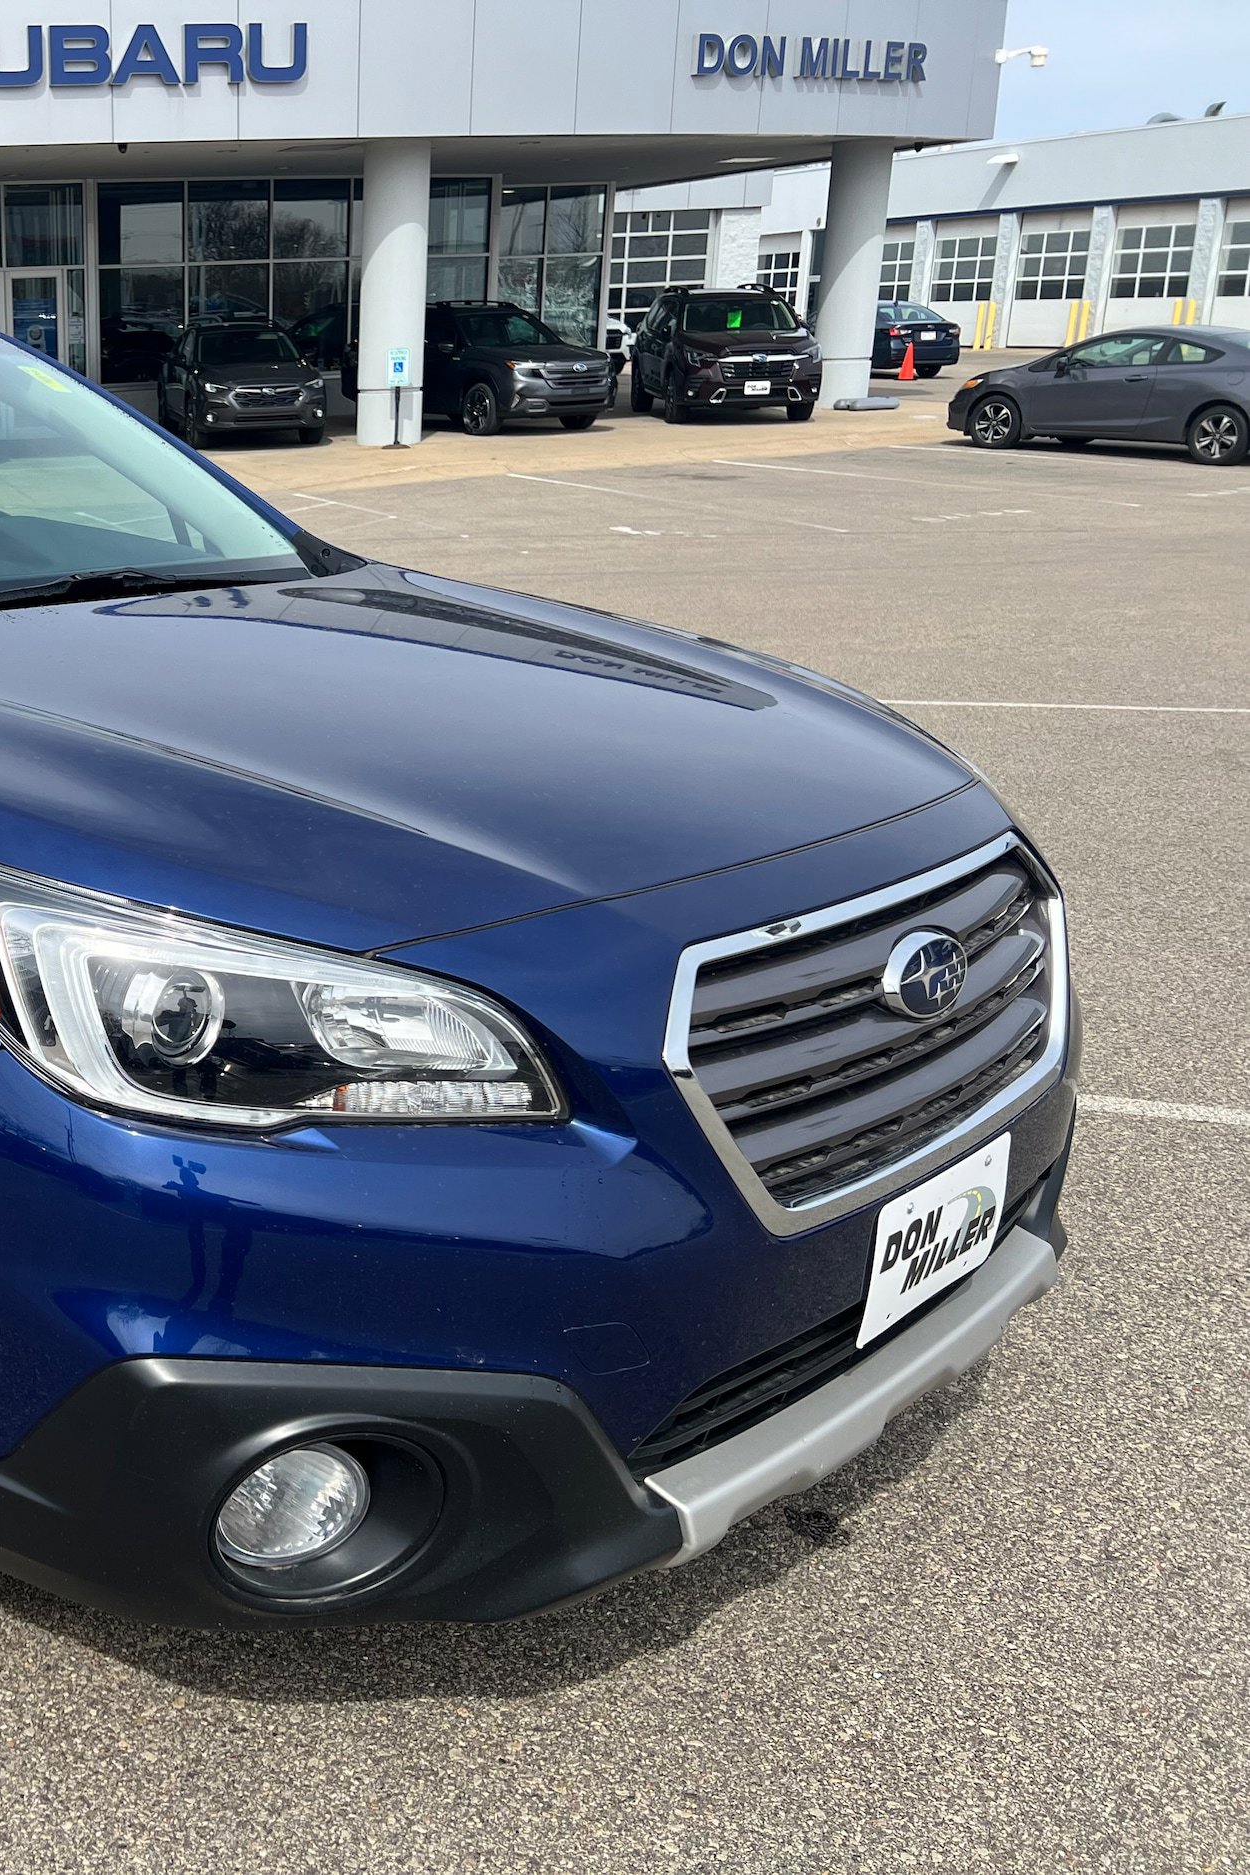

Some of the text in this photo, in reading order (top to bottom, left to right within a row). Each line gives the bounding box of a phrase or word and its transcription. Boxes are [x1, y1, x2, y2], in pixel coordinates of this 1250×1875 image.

[695, 33, 928, 81] DON MILLER
[880, 1205, 943, 1275] DON
[900, 1206, 996, 1295] MILLER
